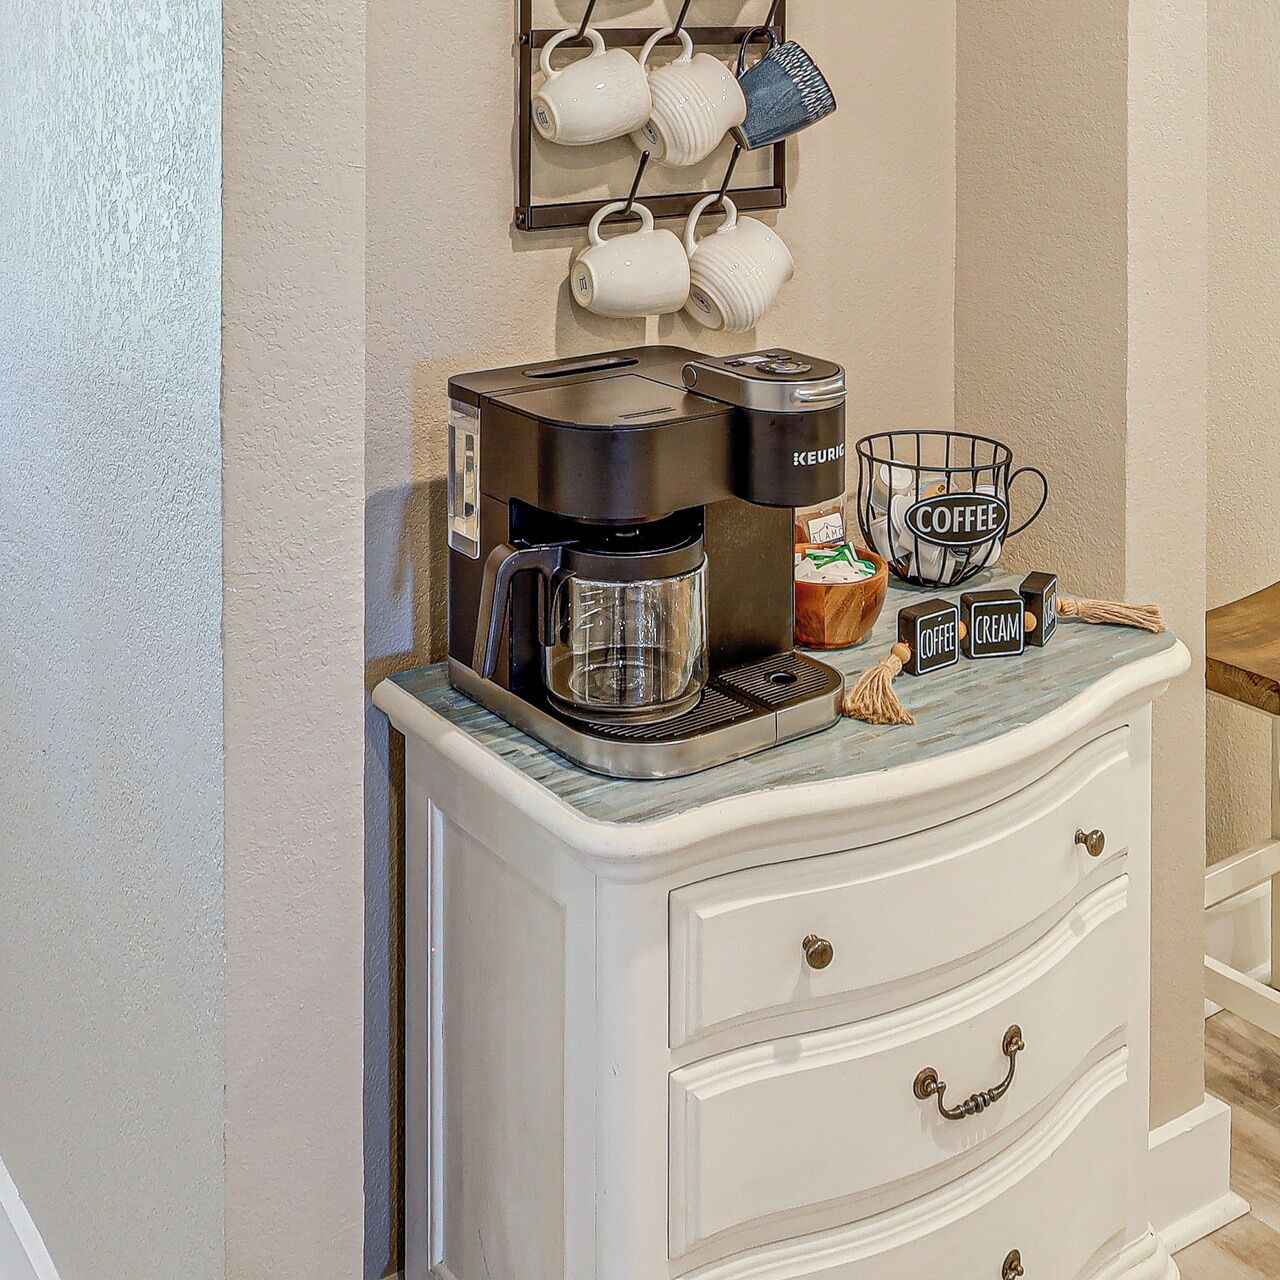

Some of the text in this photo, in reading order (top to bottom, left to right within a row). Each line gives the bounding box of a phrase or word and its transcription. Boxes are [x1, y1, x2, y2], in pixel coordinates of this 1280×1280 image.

[916, 503, 998, 533] COFFEE
[920, 622, 955, 659] COFFEE
[975, 613, 1020, 644] CREAM
